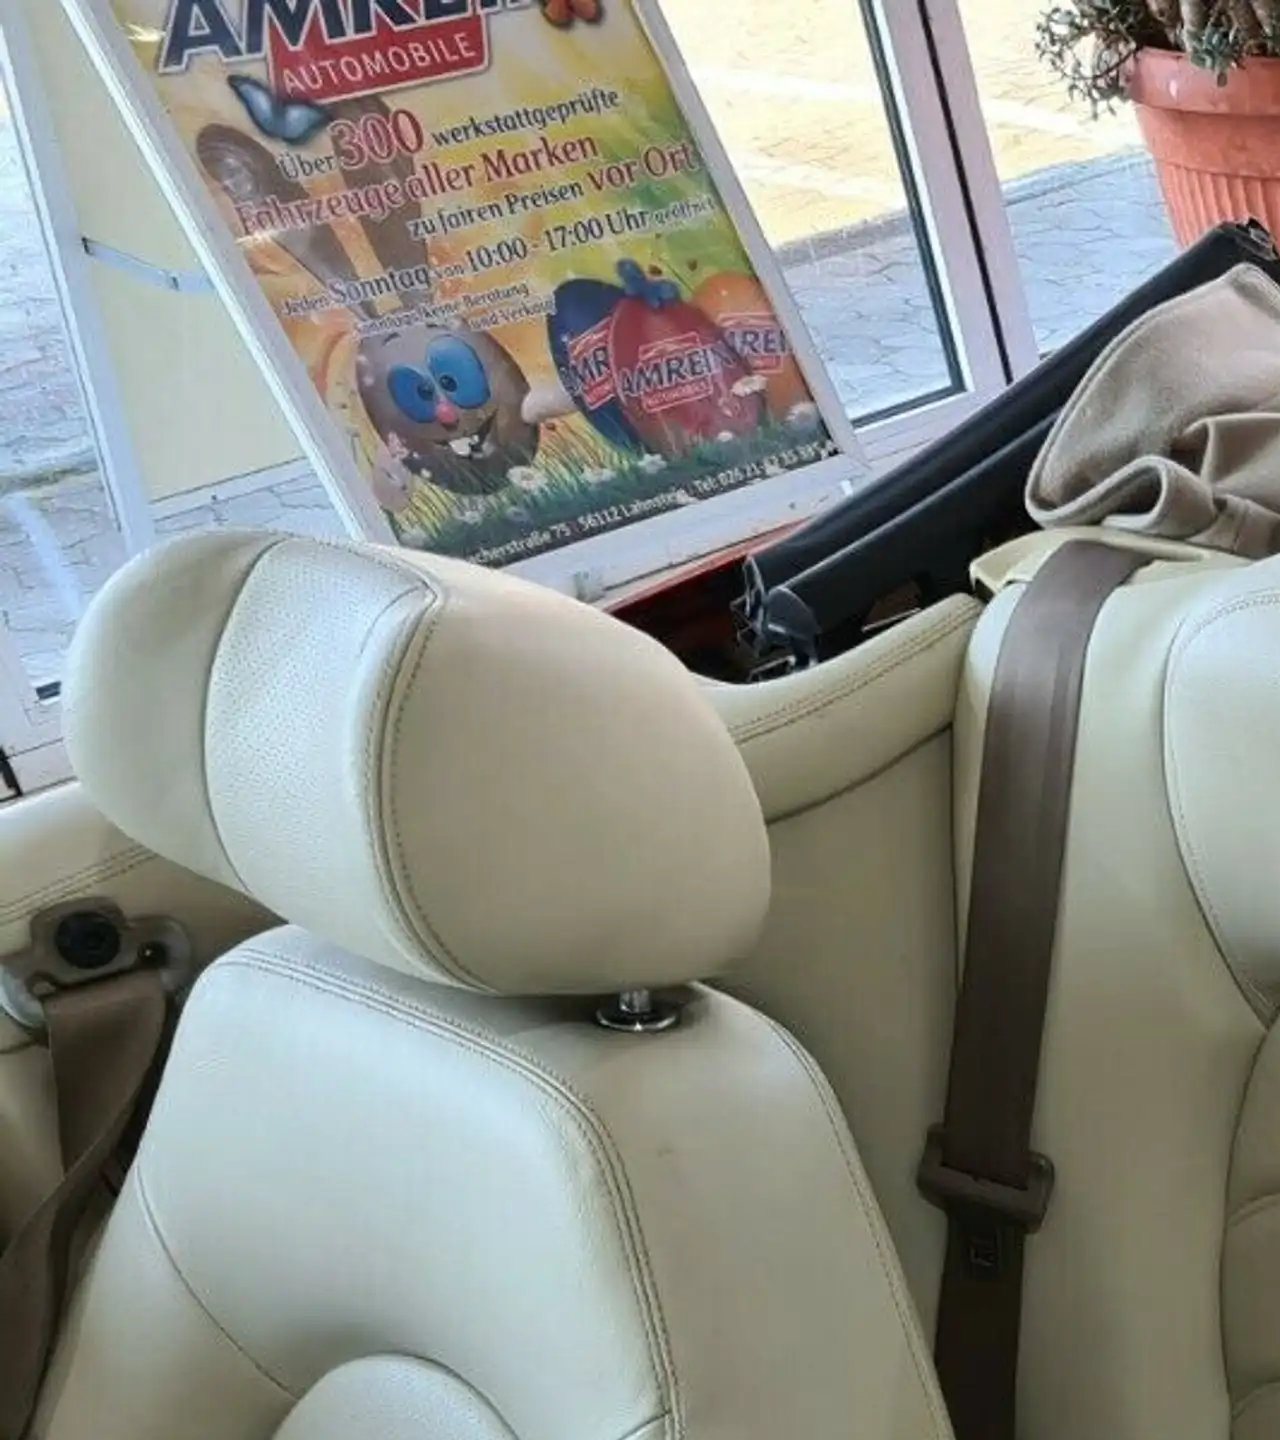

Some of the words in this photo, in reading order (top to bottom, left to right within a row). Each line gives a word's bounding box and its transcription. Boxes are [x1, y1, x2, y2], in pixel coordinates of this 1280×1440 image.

[282, 32, 477, 96] AUTOMOBILE
[277, 154, 337, 180] Über
[329, 108, 425, 170] 300
[430, 87, 619, 147] werkstattgeprüfte
[236, 180, 400, 235] Fahrzeuge
[404, 163, 475, 200] aller
[481, 135, 599, 183] Marken
[410, 218, 435, 238] zu
[439, 200, 504, 235] fairen
[505, 180, 584, 216] Preisen
[587, 160, 640, 192] vor
[643, 142, 697, 178] Ort
[330, 265, 431, 304] Sonntag
[434, 264, 465, 280] von
[465, 237, 527, 273] 10:00
[545, 218, 604, 251] 17:00
[607, 208, 650, 235] Uhr
[620, 345, 741, 396] AMREIN
